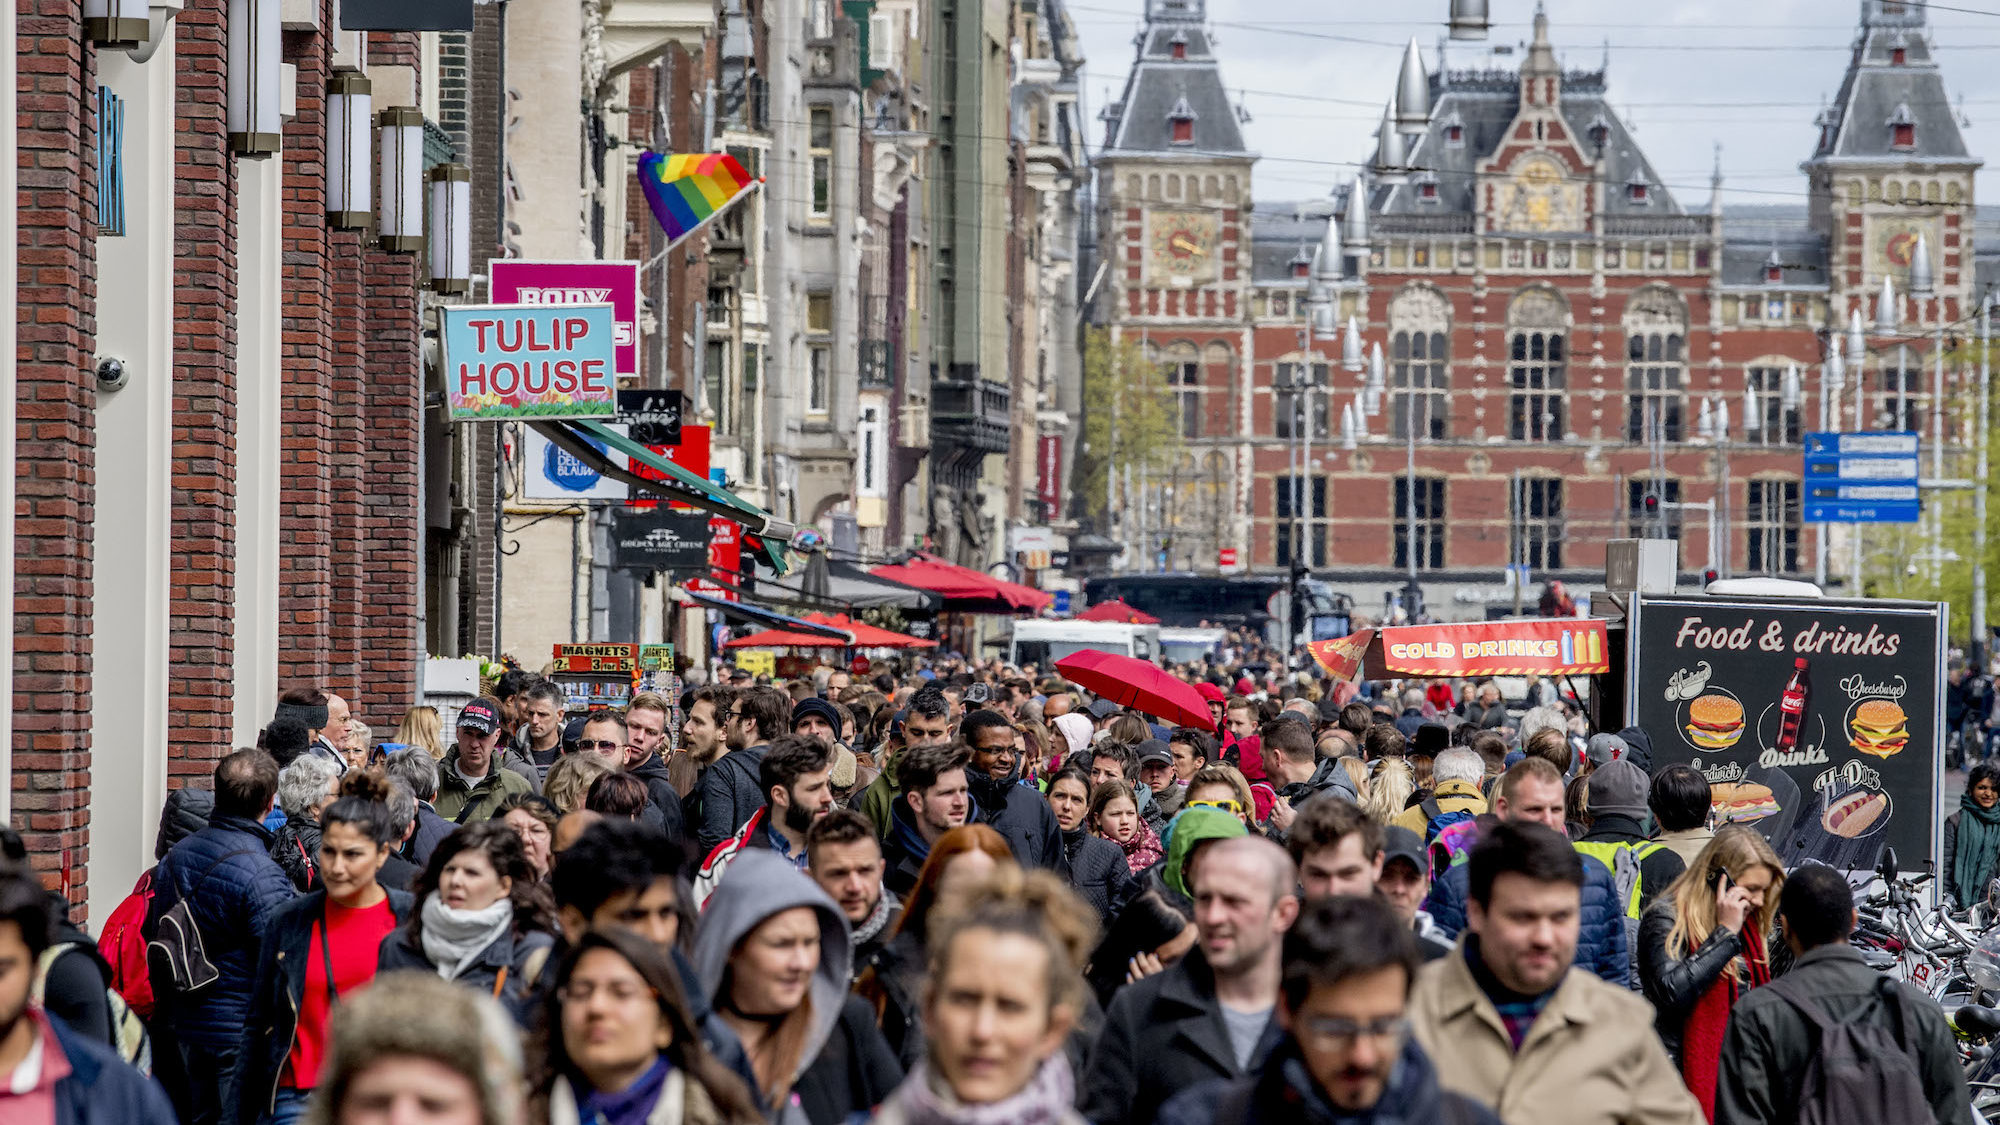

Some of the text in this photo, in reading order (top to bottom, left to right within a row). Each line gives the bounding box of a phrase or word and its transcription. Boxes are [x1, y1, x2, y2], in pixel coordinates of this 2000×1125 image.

[468, 318, 590, 353] TULIP
[459, 359, 606, 396] HOUSE
[620, 540, 654, 548] GOLDEN
[1675, 616, 1901, 656] Food & drinks
[562, 645, 629, 656] MAGNETS
[1391, 639, 1559, 659] COLD DRINKS
[592, 659, 600, 669] 3
[1839, 674, 1907, 699] Cheeseburger
[1758, 744, 1830, 769] Drinks
[1691, 757, 1742, 783] Sndwich
